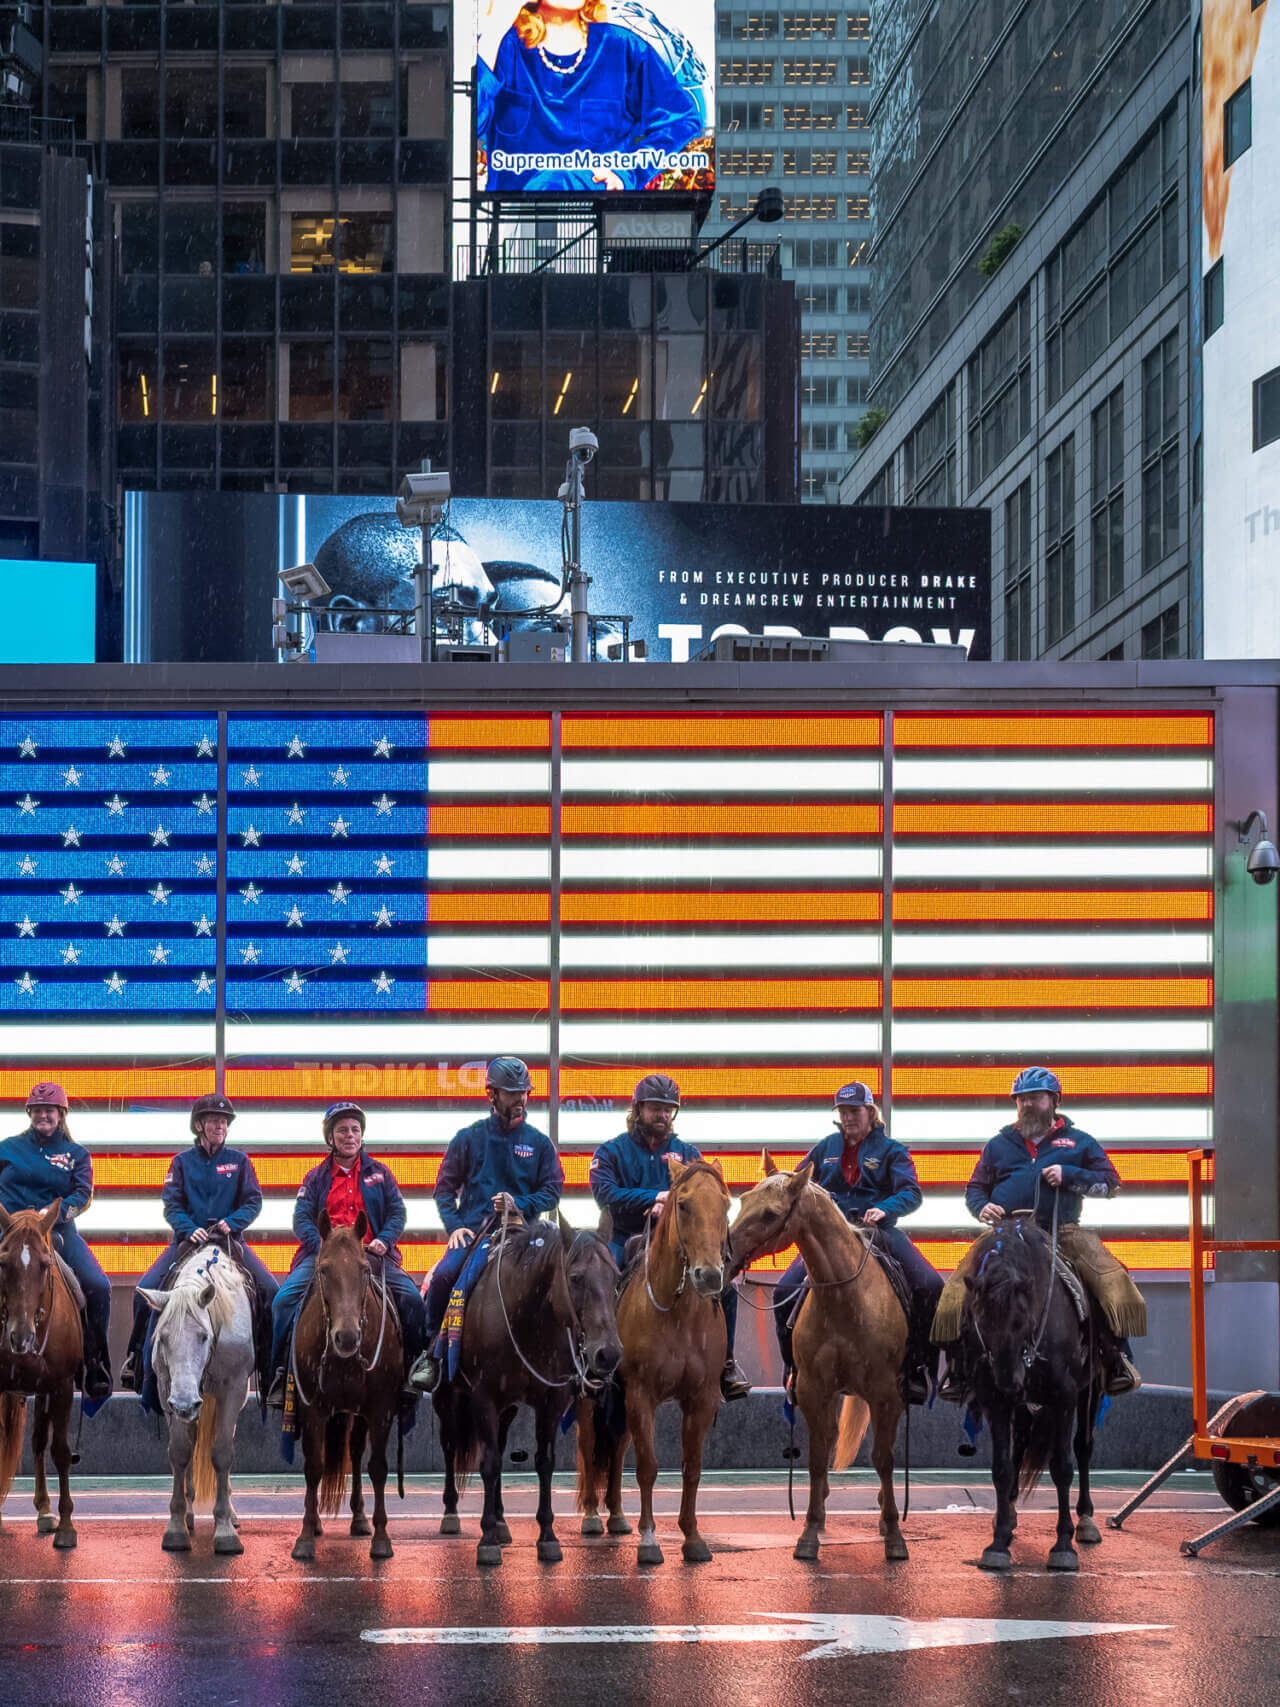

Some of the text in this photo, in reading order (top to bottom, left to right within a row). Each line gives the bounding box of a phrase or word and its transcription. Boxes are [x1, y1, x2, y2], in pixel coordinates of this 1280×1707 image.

[492, 150, 708, 174] SupremeMasterTV.com
[658, 570, 977, 588] FROM EXECUTIVE PRODUCER DRAKE
[679, 592, 956, 609] & DREAMCREW ENTERTAINMENT
